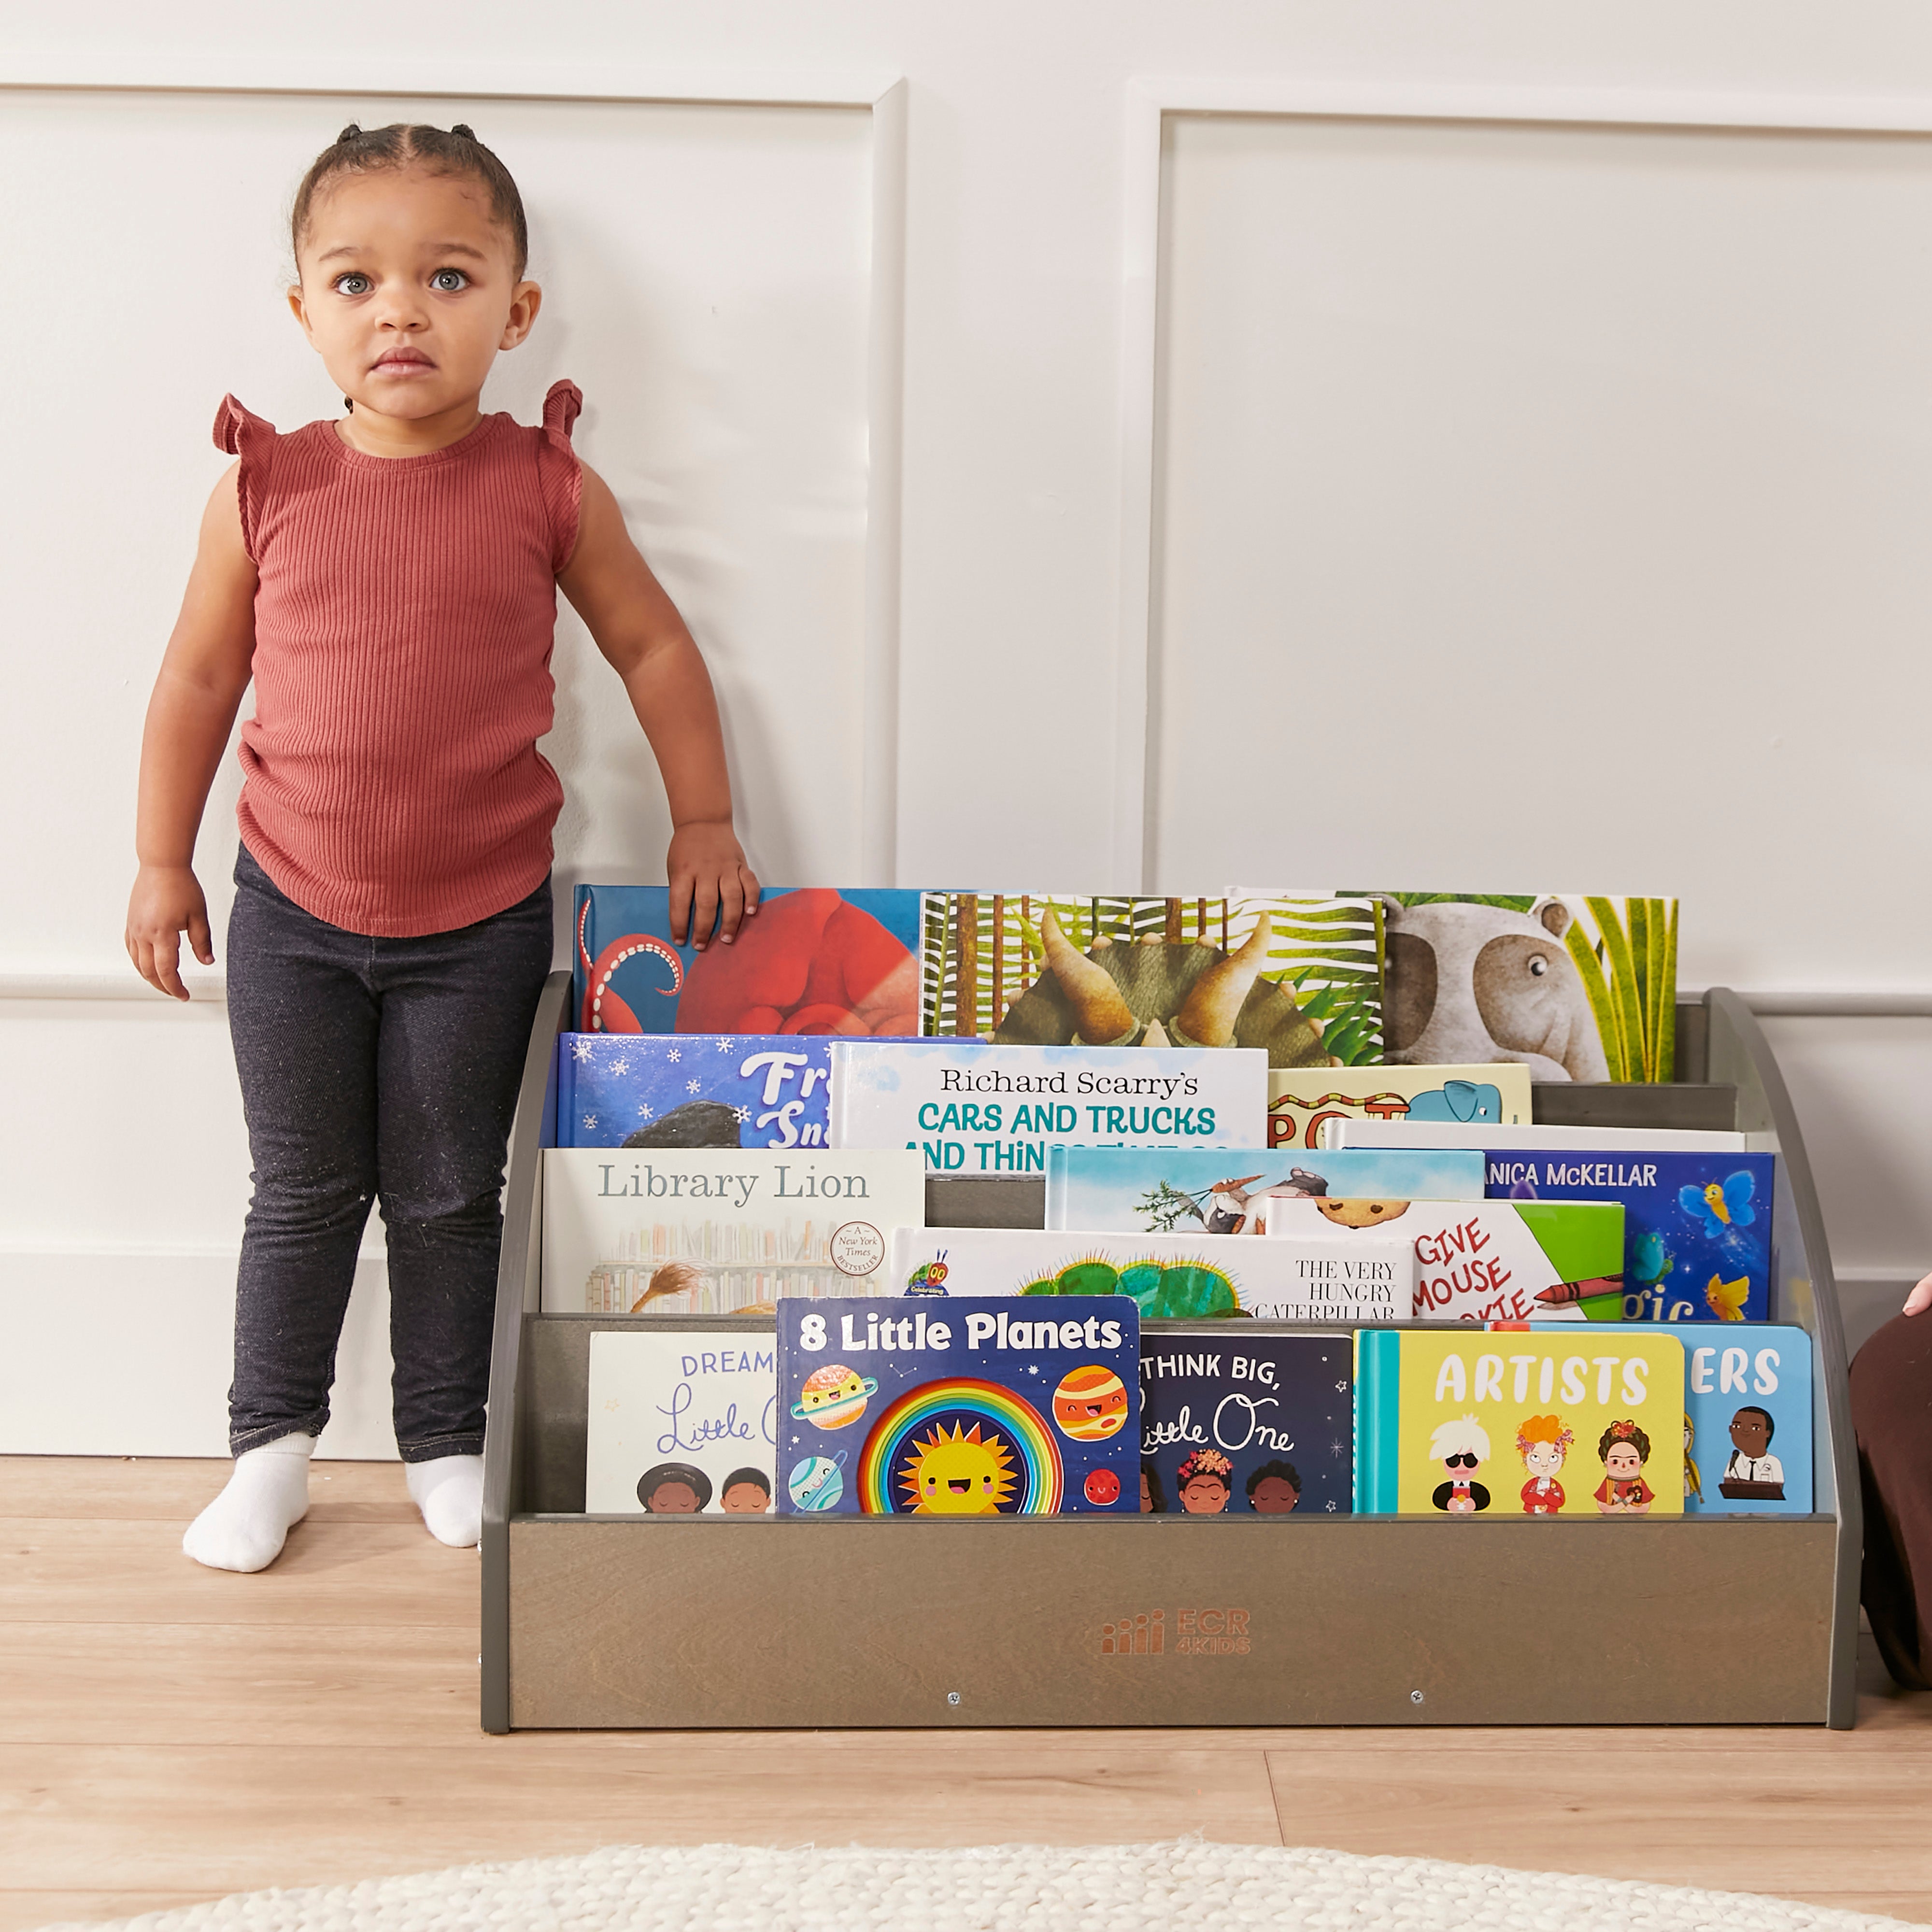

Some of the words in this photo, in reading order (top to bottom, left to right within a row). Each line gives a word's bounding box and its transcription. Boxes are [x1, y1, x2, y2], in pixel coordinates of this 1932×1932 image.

[740, 1051, 832, 1105] Fr
[940, 1069, 1069, 1094] Richard
[1077, 1072, 1198, 1100] Scarry's
[756, 1100, 831, 1149] Sn
[918, 1102, 1002, 1133] CARS
[1010, 1102, 1077, 1134] AND
[1086, 1105, 1216, 1136] TRUCKS
[905, 1139, 965, 1170] ND
[597, 1164, 760, 1208] Library
[774, 1165, 870, 1198] Lion
[1547, 1163, 1657, 1187] McKELLAR
[838, 1236, 858, 1245] New
[860, 1236, 878, 1245] York
[854, 1226, 861, 1235] A
[1415, 1217, 1490, 1267] GIVE
[837, 1255, 878, 1271] BESTSELLER
[845, 1247, 871, 1256] Times
[1295, 1260, 1337, 1279] THE
[1343, 1261, 1398, 1280] VERY
[1308, 1282, 1397, 1303] HUNGRY
[1413, 1256, 1512, 1317] MOUSE
[800, 1313, 827, 1351] 8
[840, 1312, 952, 1351] Little
[965, 1311, 1122, 1350] Planets
[682, 1351, 773, 1377] DREAM
[1140, 1353, 1222, 1379] THINK
[1232, 1356, 1280, 1391] BIG,
[1435, 1354, 1649, 1406] ARTISTS
[1691, 1347, 1781, 1396] ERS
[656, 1382, 755, 1454] Little
[1213, 1393, 1295, 1452] One
[1177, 1608, 1250, 1635] ECR
[1175, 1636, 1251, 1655] 4KIDS
